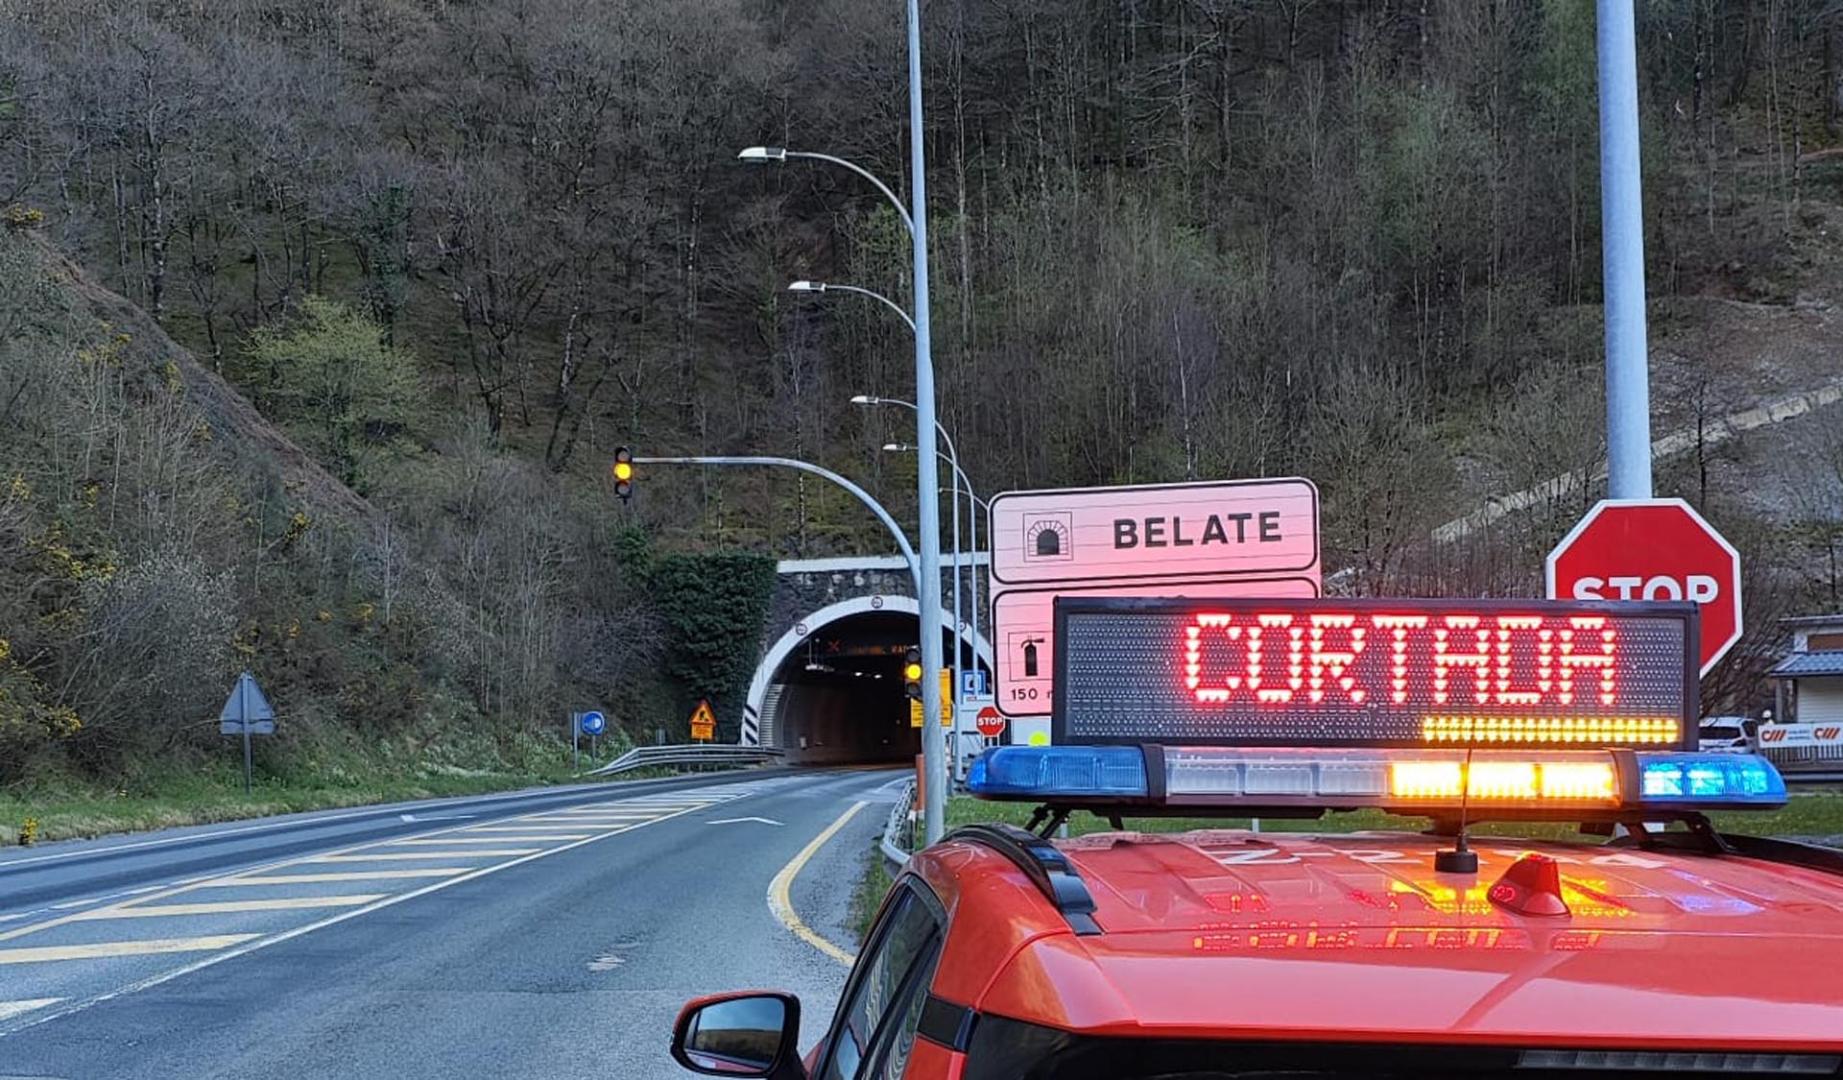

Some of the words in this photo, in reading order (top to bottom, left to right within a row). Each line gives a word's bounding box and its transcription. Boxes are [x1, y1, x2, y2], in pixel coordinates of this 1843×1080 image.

[1113, 511, 1283, 549] BELATE
[1572, 575, 1719, 603] STOP
[1184, 613, 1616, 705] CORTADA
[1011, 688, 1038, 700] 150
[977, 717, 1003, 726] STOP
